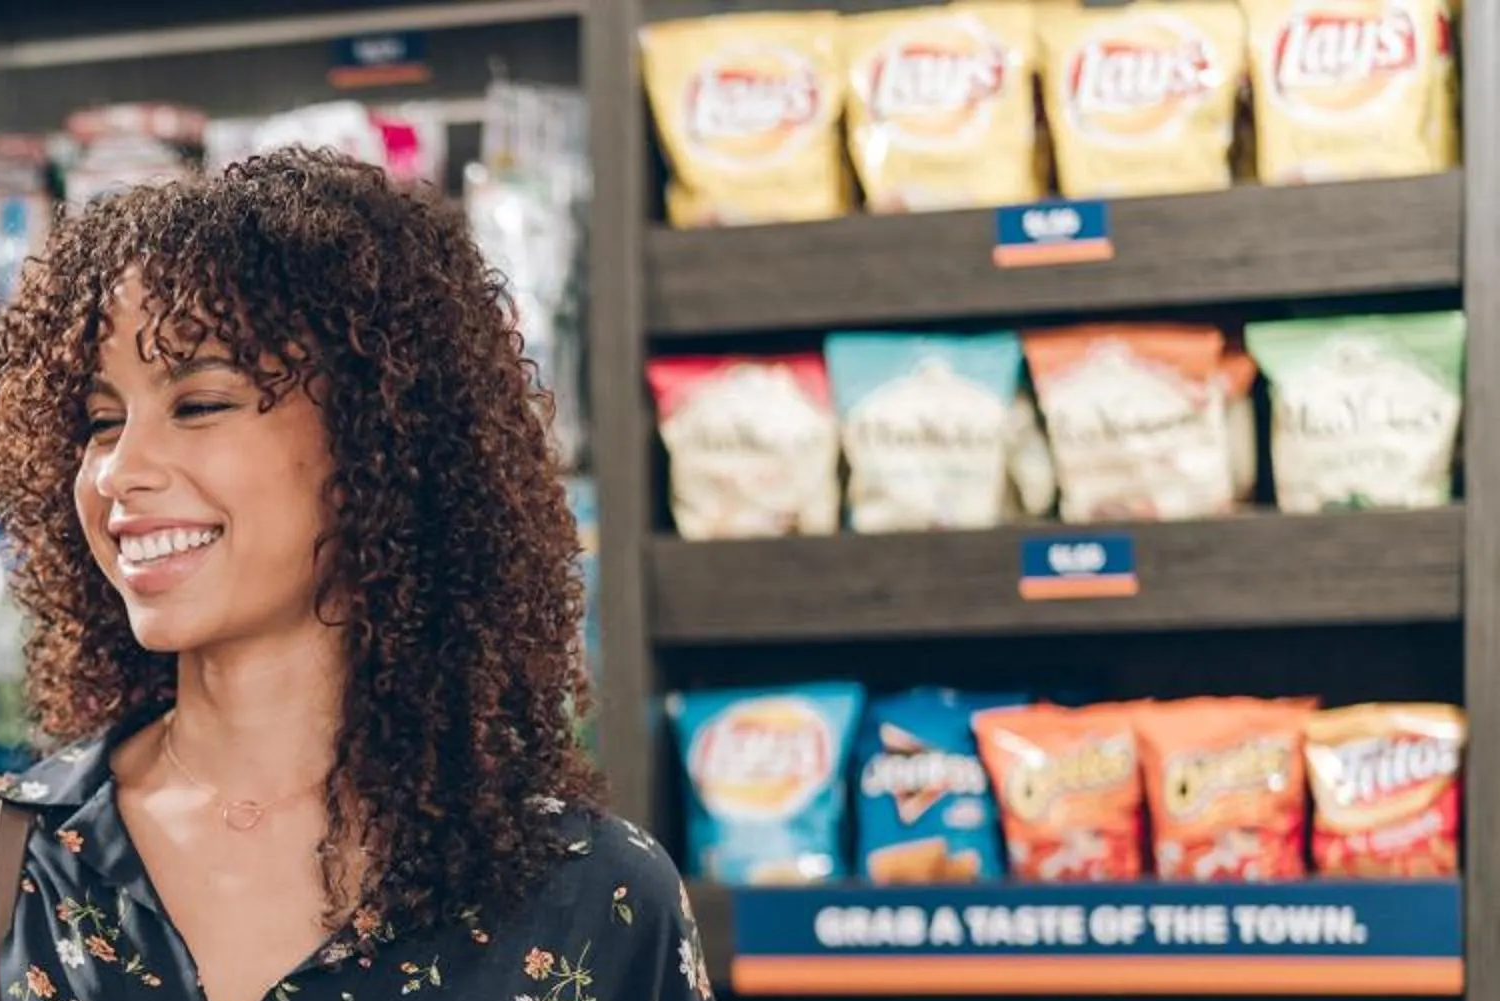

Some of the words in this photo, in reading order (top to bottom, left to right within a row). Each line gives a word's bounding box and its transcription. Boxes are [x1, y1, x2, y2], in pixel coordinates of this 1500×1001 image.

[814, 906, 926, 947] GRAB
[929, 906, 963, 946] A
[964, 906, 1085, 945] TASTE
[1088, 905, 1145, 945] OF
[1149, 905, 1228, 944] THE
[1232, 904, 1368, 944] TOWN.
